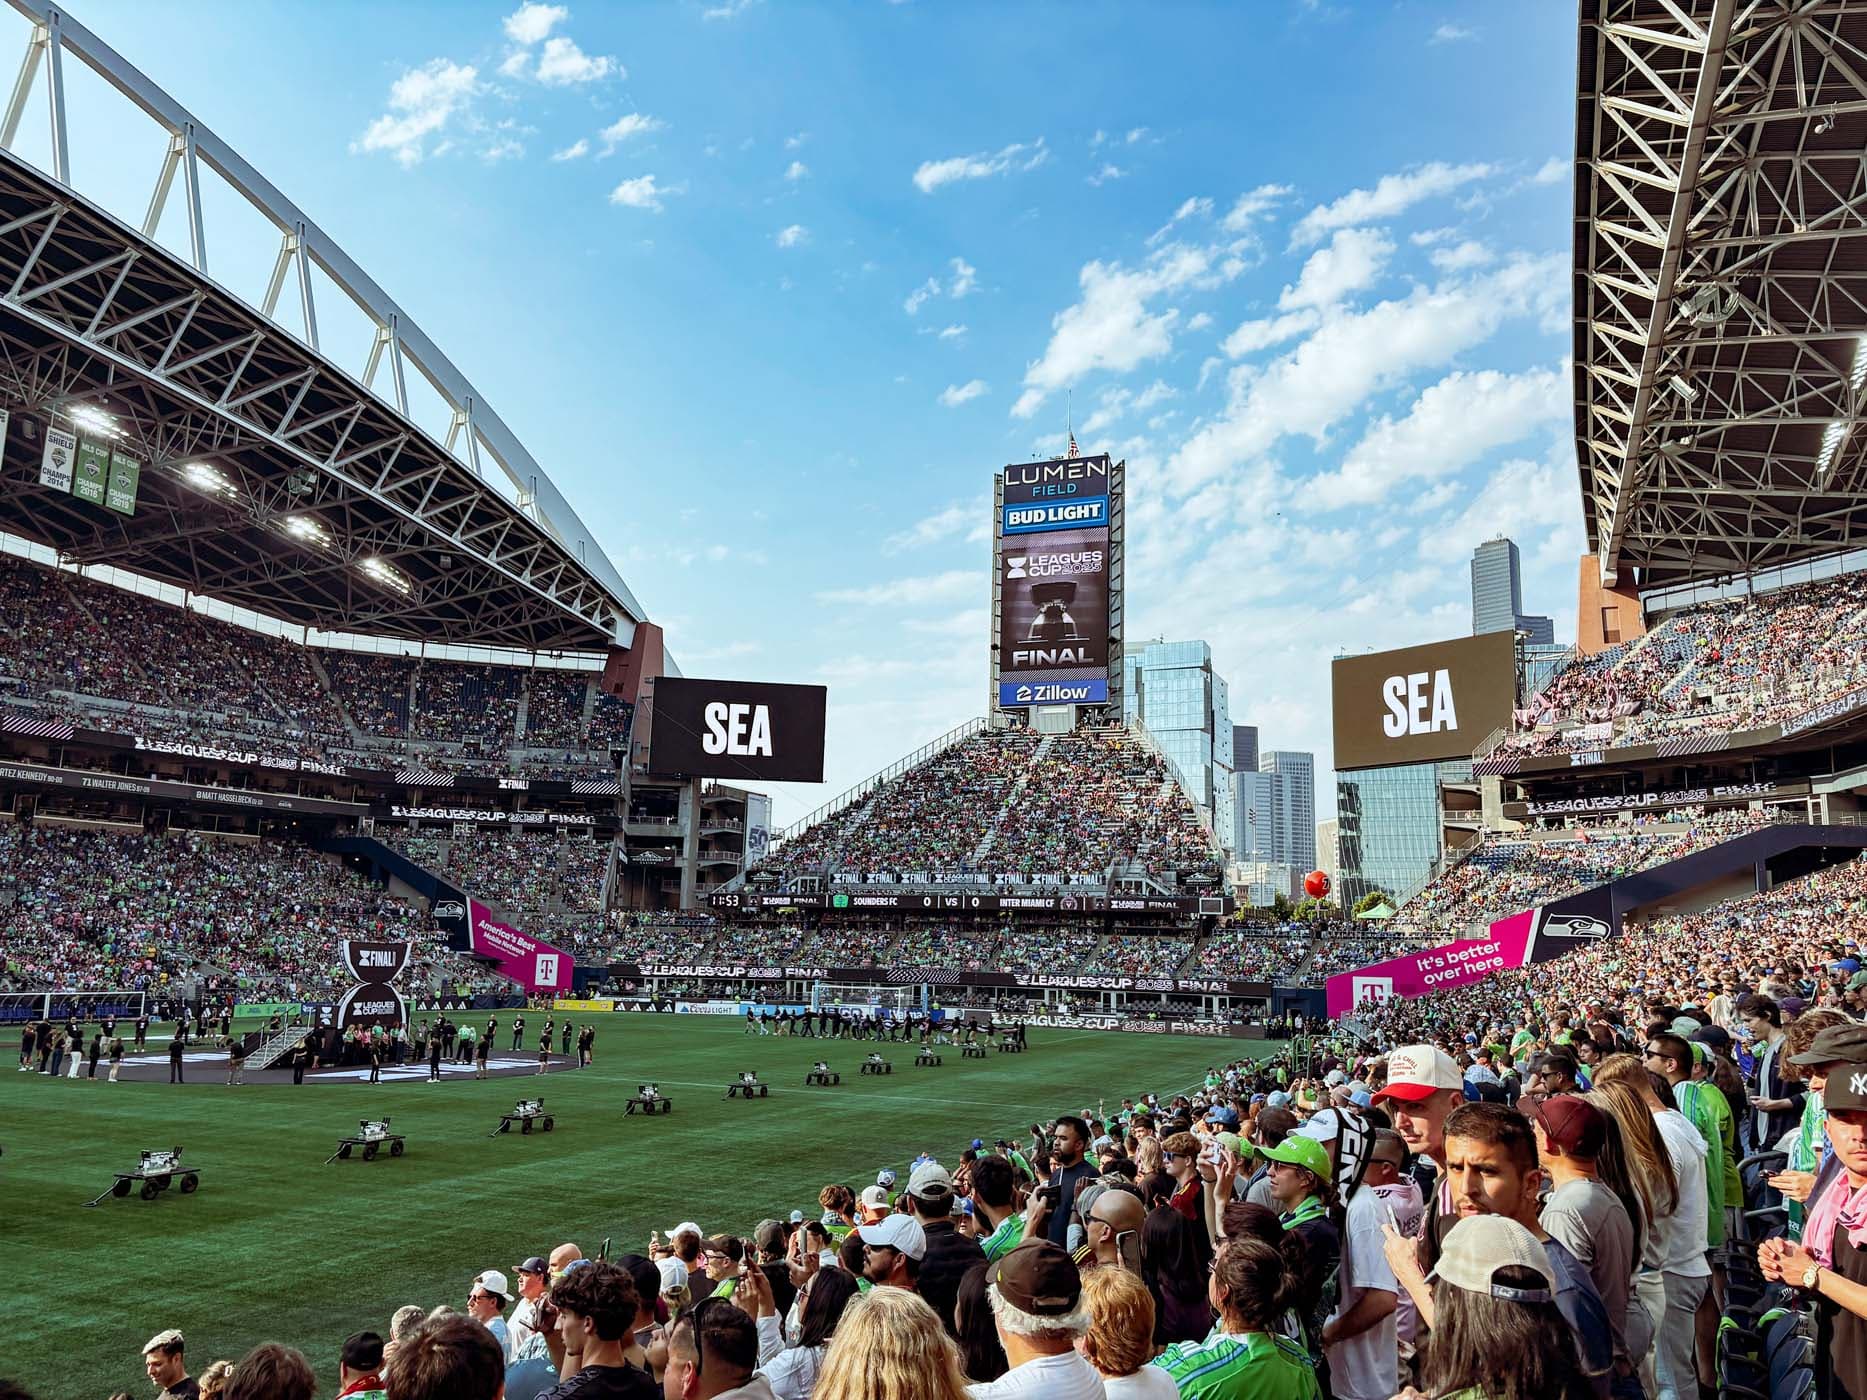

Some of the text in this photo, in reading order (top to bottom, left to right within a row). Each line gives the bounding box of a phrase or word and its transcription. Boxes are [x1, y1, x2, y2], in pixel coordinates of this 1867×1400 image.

[48, 434, 74, 449] SHIELD
[42, 467, 71, 482] CHAMPS
[1005, 460, 1106, 486] LUMEN
[47, 476, 64, 487] 2014
[1032, 483, 1077, 497] FIELD
[1008, 504, 1101, 525] BUD LIGHT
[1028, 550, 1103, 566] LEAGUES
[1028, 565, 1061, 577] CUP
[1012, 647, 1095, 667] FINAL
[1034, 684, 1088, 701] Zillow
[1382, 668, 1458, 738] SEA
[702, 702, 773, 757] SEA
[228, 751, 258, 764] CUP
[1580, 751, 1603, 765] FINAL
[0, 767, 17, 778] RTEZ
[17, 769, 48, 782] KENNEDY
[81, 777, 92, 787] 71
[92, 778, 117, 790] WALTER
[117, 781, 137, 792] JONES
[508, 780, 527, 790] FINAL
[202, 791, 218, 800] MATT
[218, 794, 252, 805] HASSELBECK
[1623, 793, 1658, 807] CUP
[1662, 788, 1708, 804] 2025
[476, 809, 506, 822] CUP
[842, 873, 860, 884] FINAL
[876, 872, 894, 884] FINAL
[910, 872, 929, 884] FINAL
[974, 873, 989, 884] FINAL
[1004, 873, 1024, 884] FINAL
[1041, 873, 1061, 884] FINAL
[1079, 873, 1100, 885] FINAL
[712, 895, 739, 907] 11:53
[794, 896, 820, 904] FINAL
[853, 896, 899, 906] SOUNDERS FC
[923, 896, 931, 907] 0
[945, 897, 958, 907] VS
[971, 897, 980, 907] 0
[1000, 898, 1055, 908] INTER MIAMI CF
[1148, 901, 1179, 909] FINAL
[478, 919, 518, 943] America's
[516, 937, 536, 952] Best
[483, 931, 502, 945] Mobile
[502, 940, 526, 956] Network
[371, 951, 392, 966] FINAL
[1416, 941, 1501, 972] It's better
[541, 959, 554, 980] T
[653, 965, 714, 976] LEAGUES
[714, 966, 745, 977] CUP
[1423, 956, 1504, 985] over here
[1029, 975, 1100, 987] LEAGUES
[1099, 977, 1134, 989] CUP
[1135, 979, 1175, 991] 2025
[1362, 983, 1384, 1001] T
[362, 1001, 395, 1009] LEAGUES
[1085, 1017, 1119, 1030] CUP
[1121, 1020, 1166, 1033] 2025
